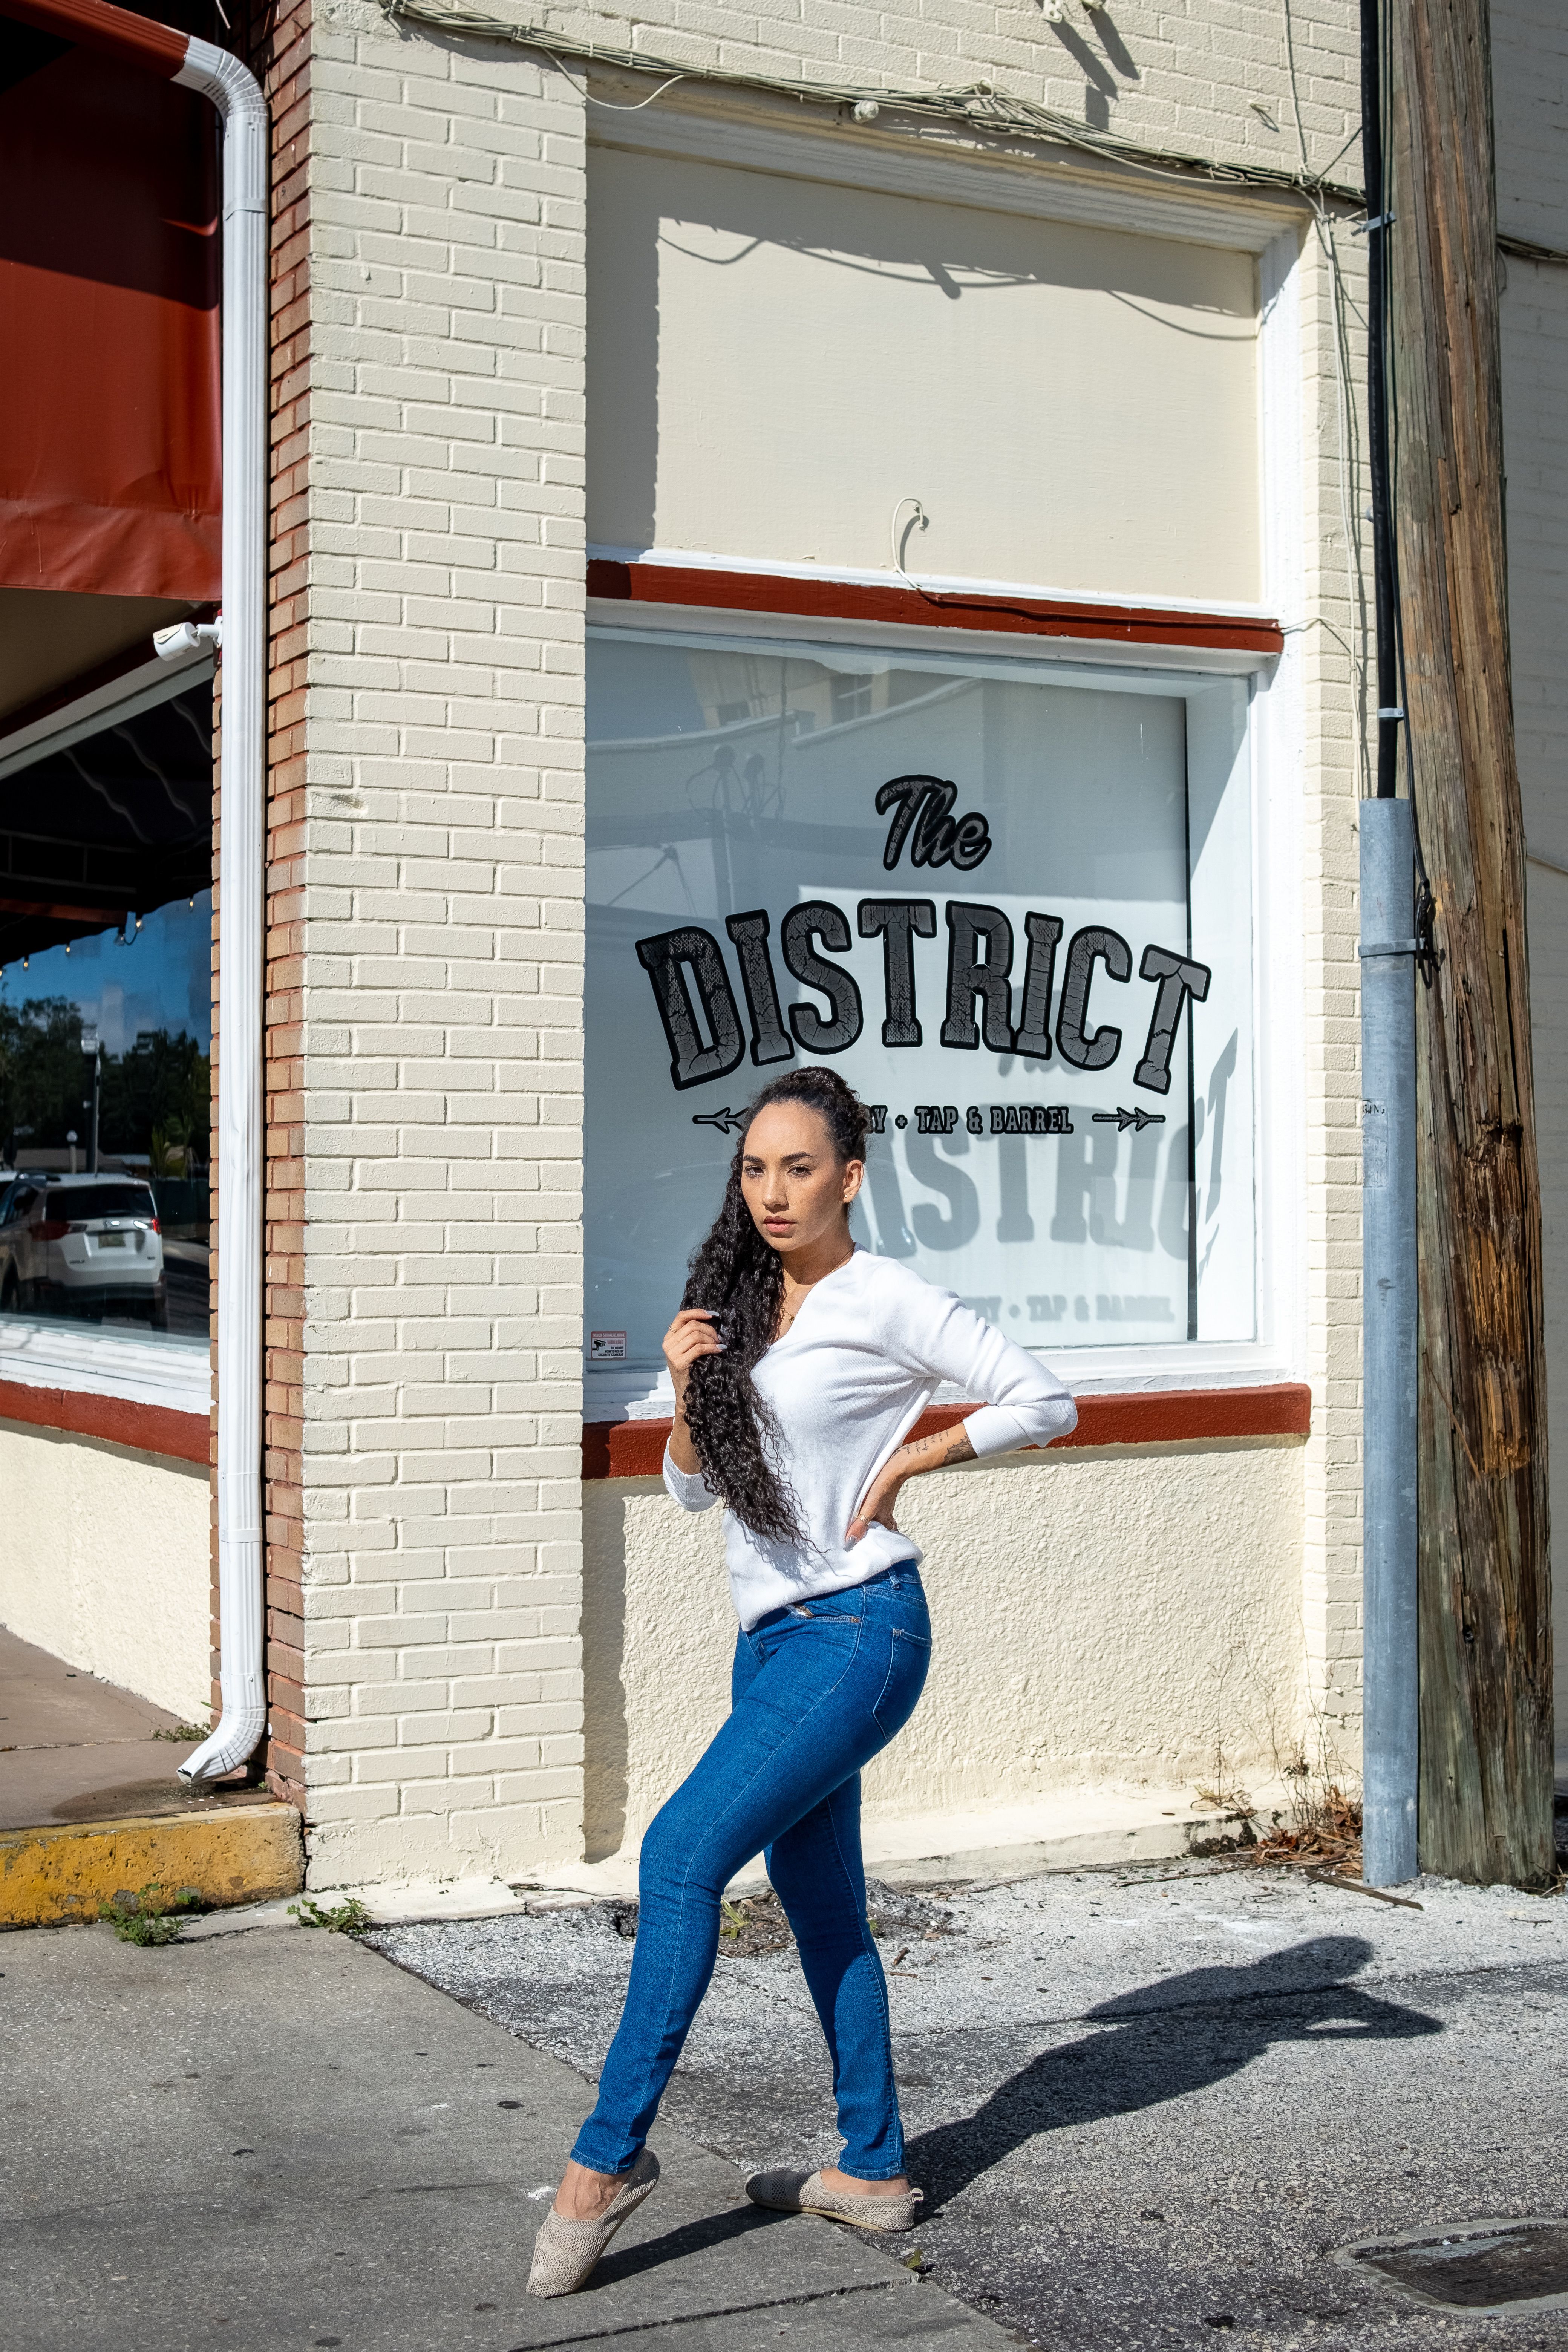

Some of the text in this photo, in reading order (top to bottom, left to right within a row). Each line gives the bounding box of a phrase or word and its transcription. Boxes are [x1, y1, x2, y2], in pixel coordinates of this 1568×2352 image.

[875, 775, 992, 871] The
[635, 899, 1212, 1095] DISTRICT
[914, 1105, 958, 1134] TAP
[967, 1106, 983, 1134] &
[990, 1106, 1074, 1134] BARREL
